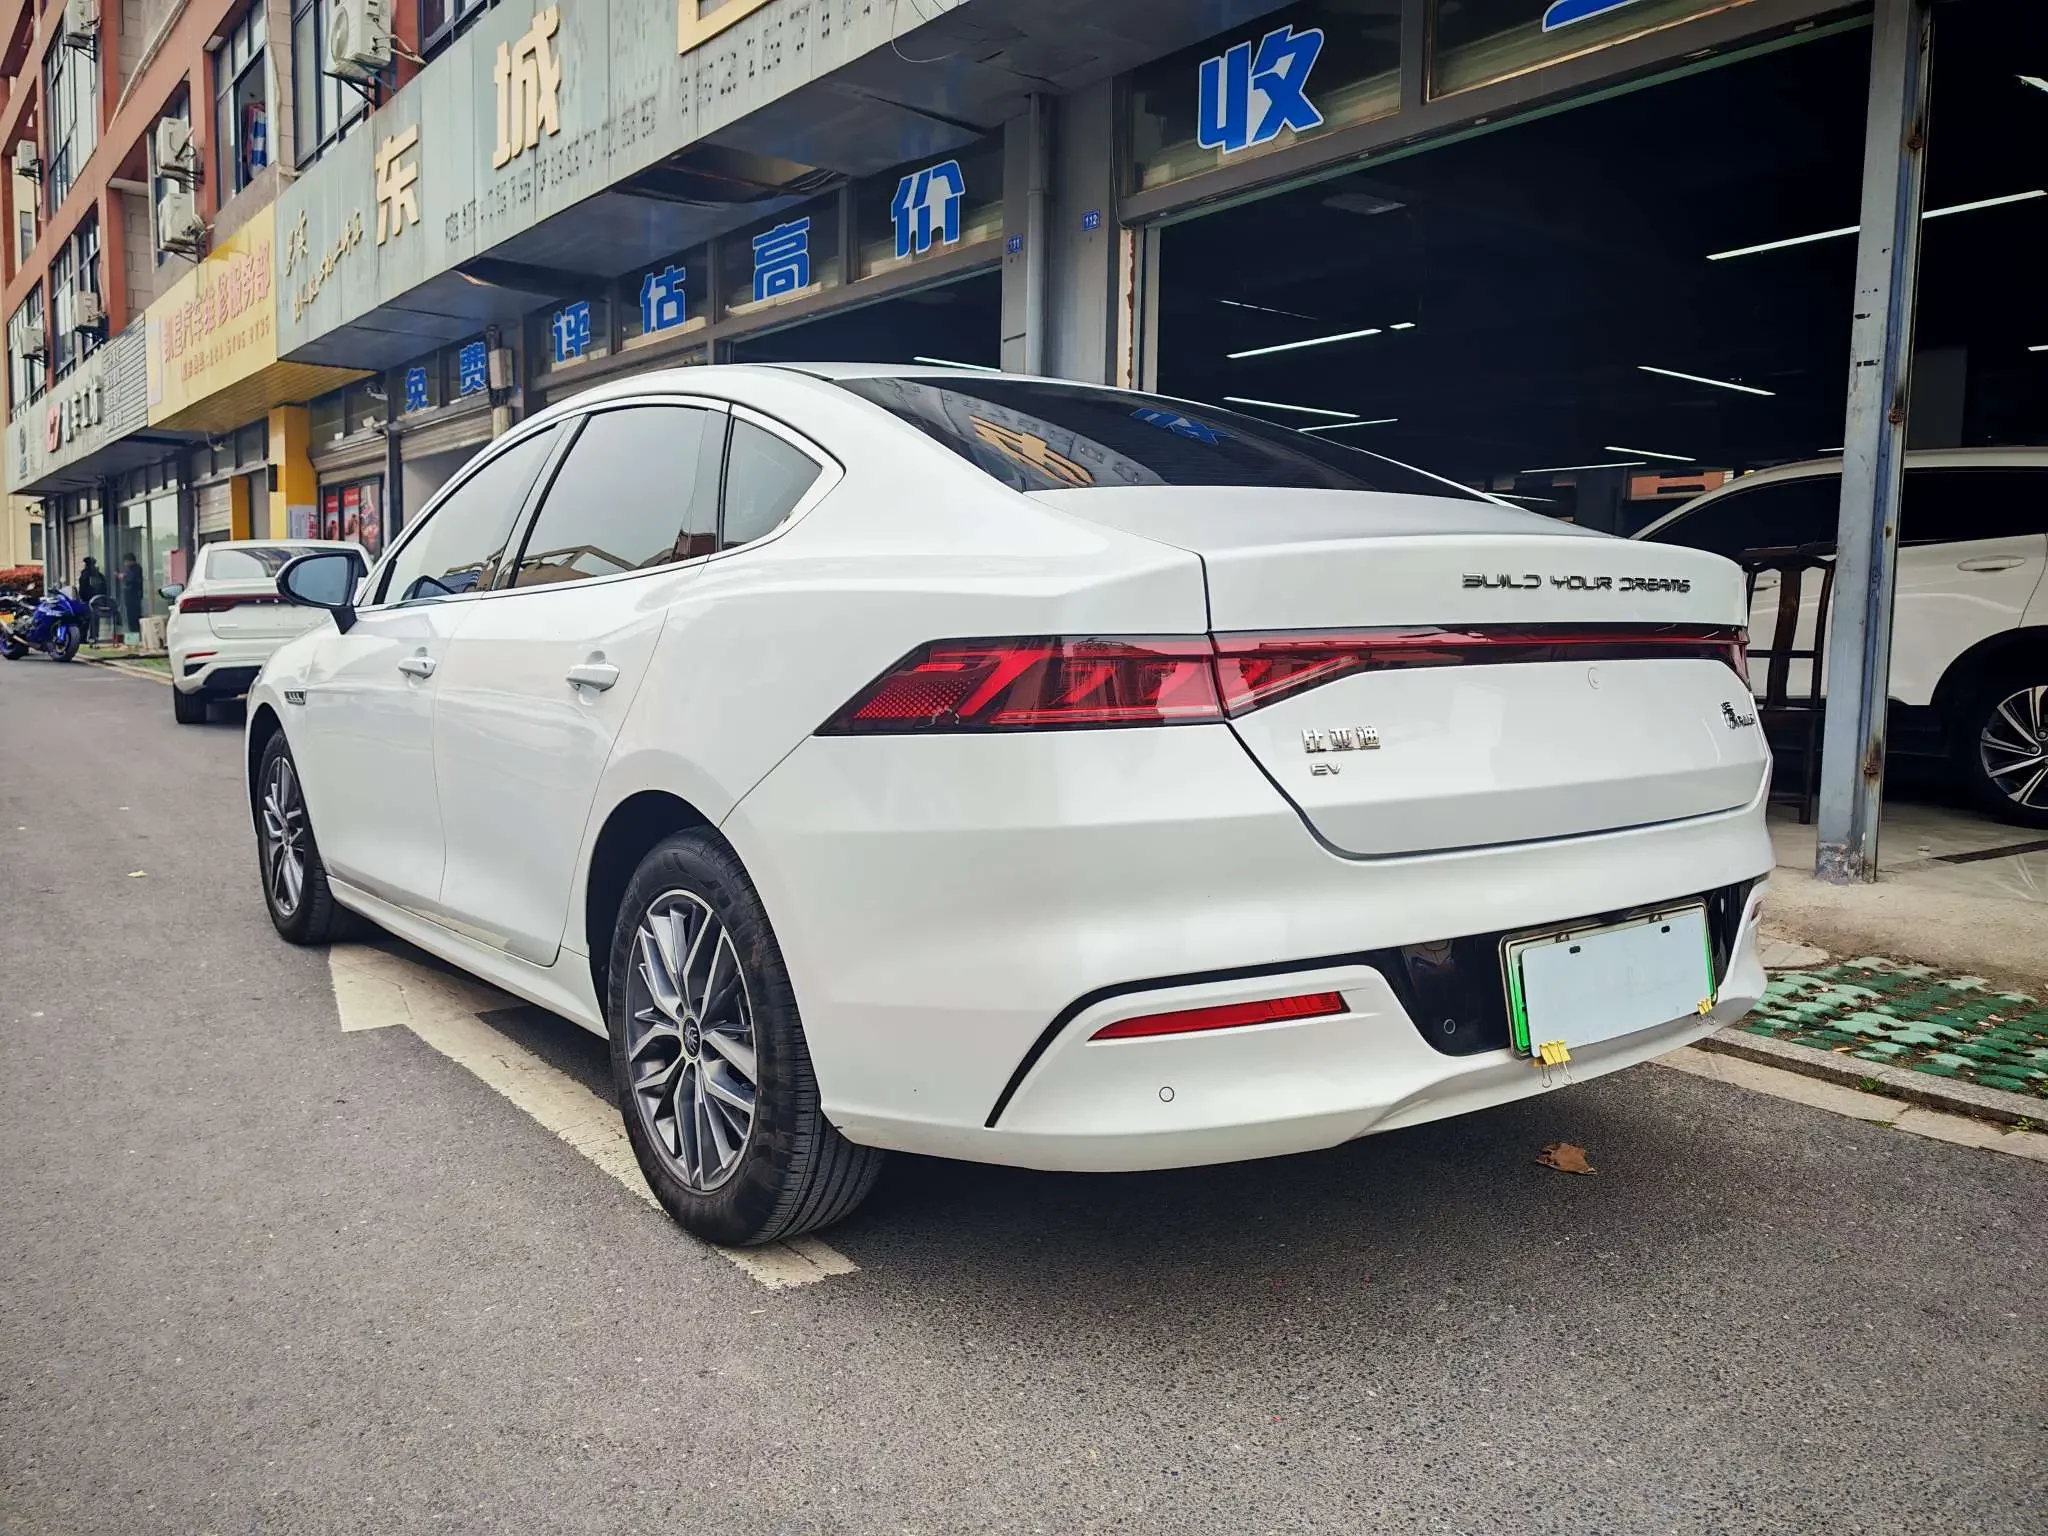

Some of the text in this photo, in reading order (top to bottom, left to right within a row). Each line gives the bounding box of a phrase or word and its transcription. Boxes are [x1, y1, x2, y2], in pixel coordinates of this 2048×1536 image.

[1462, 573, 1691, 593] BUILD YOUR DREAMS
[1302, 726, 1381, 753] 比亚迪
[1310, 763, 1341, 776] EV
